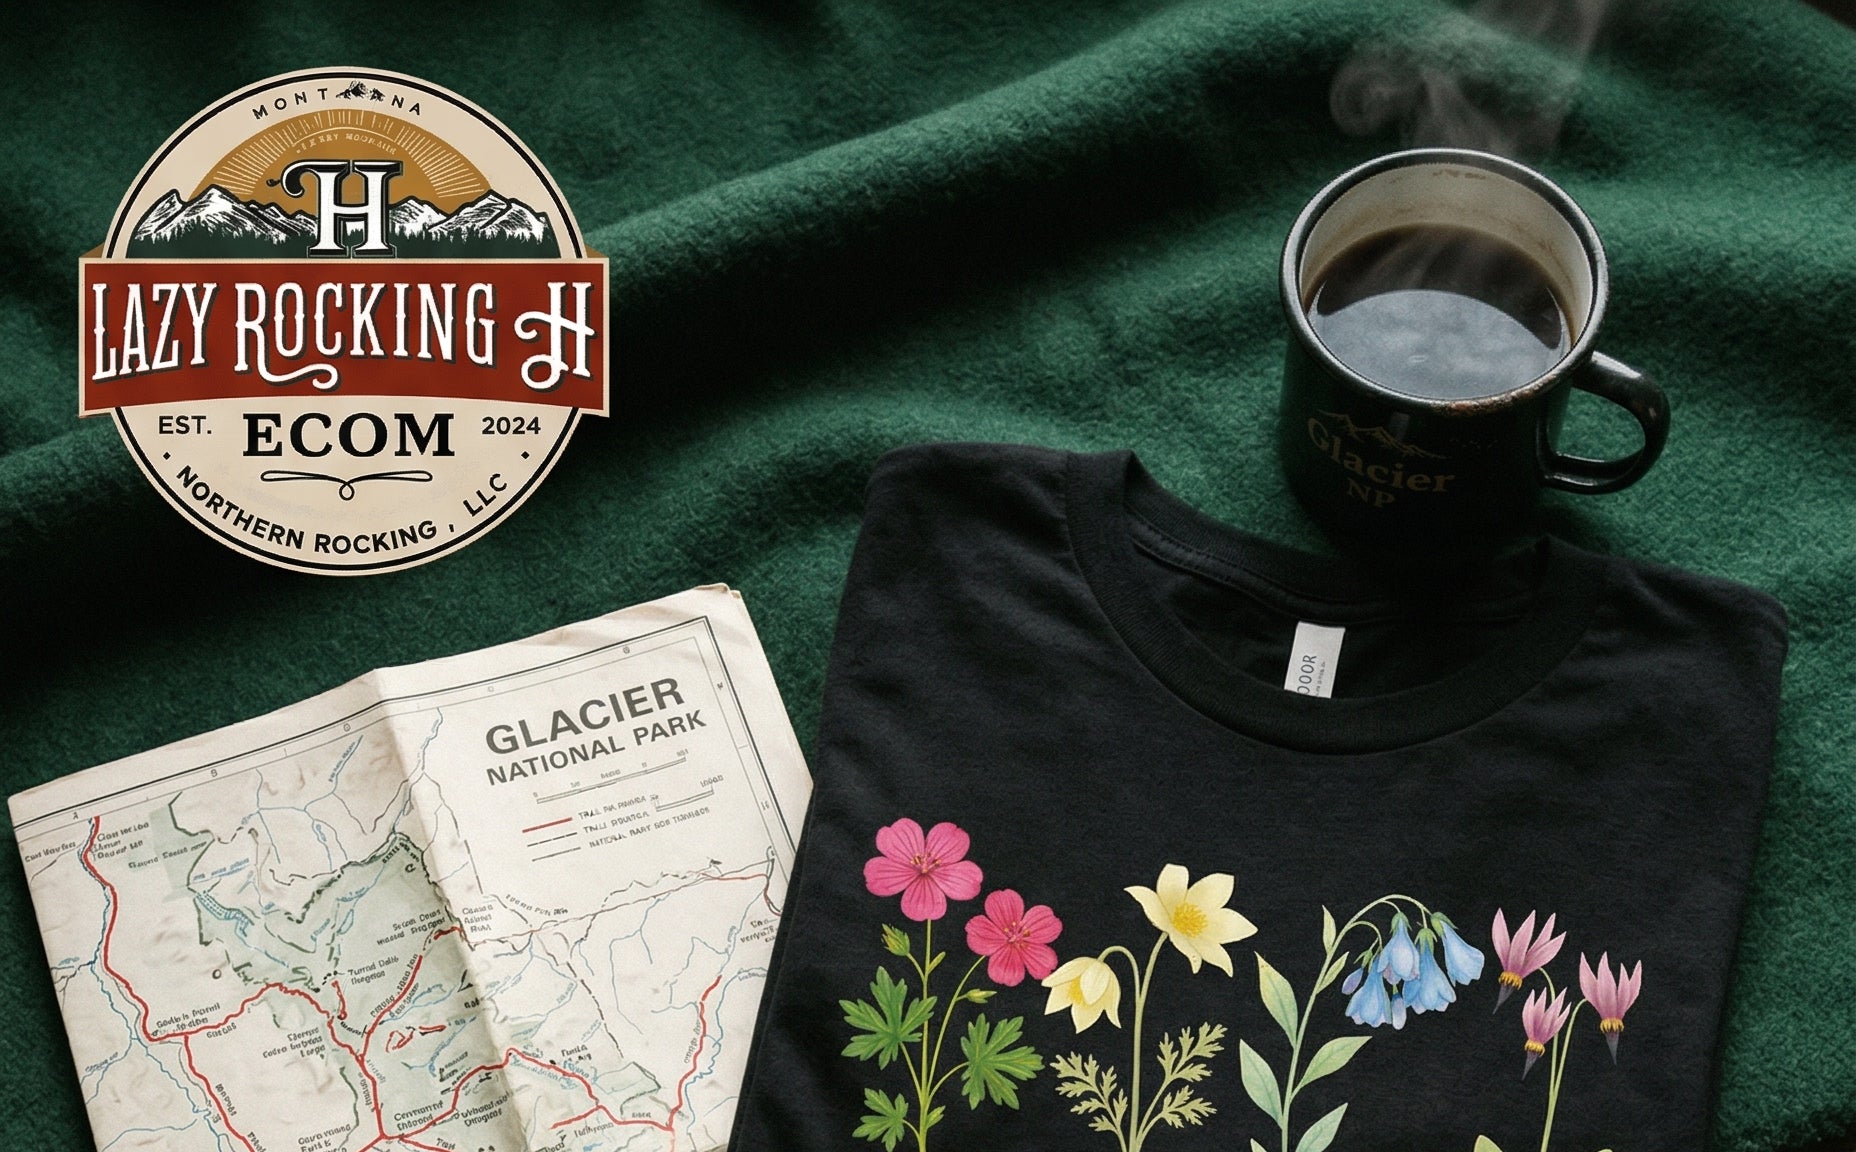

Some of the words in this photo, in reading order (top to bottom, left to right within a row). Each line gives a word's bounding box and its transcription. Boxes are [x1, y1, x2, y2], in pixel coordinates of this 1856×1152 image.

[1307, 417, 1457, 493] Glacier
[1347, 476, 1397, 508] NP
[485, 677, 685, 755] GLACIER
[487, 736, 626, 786] NATIONAL
[632, 709, 707, 746] PARK
